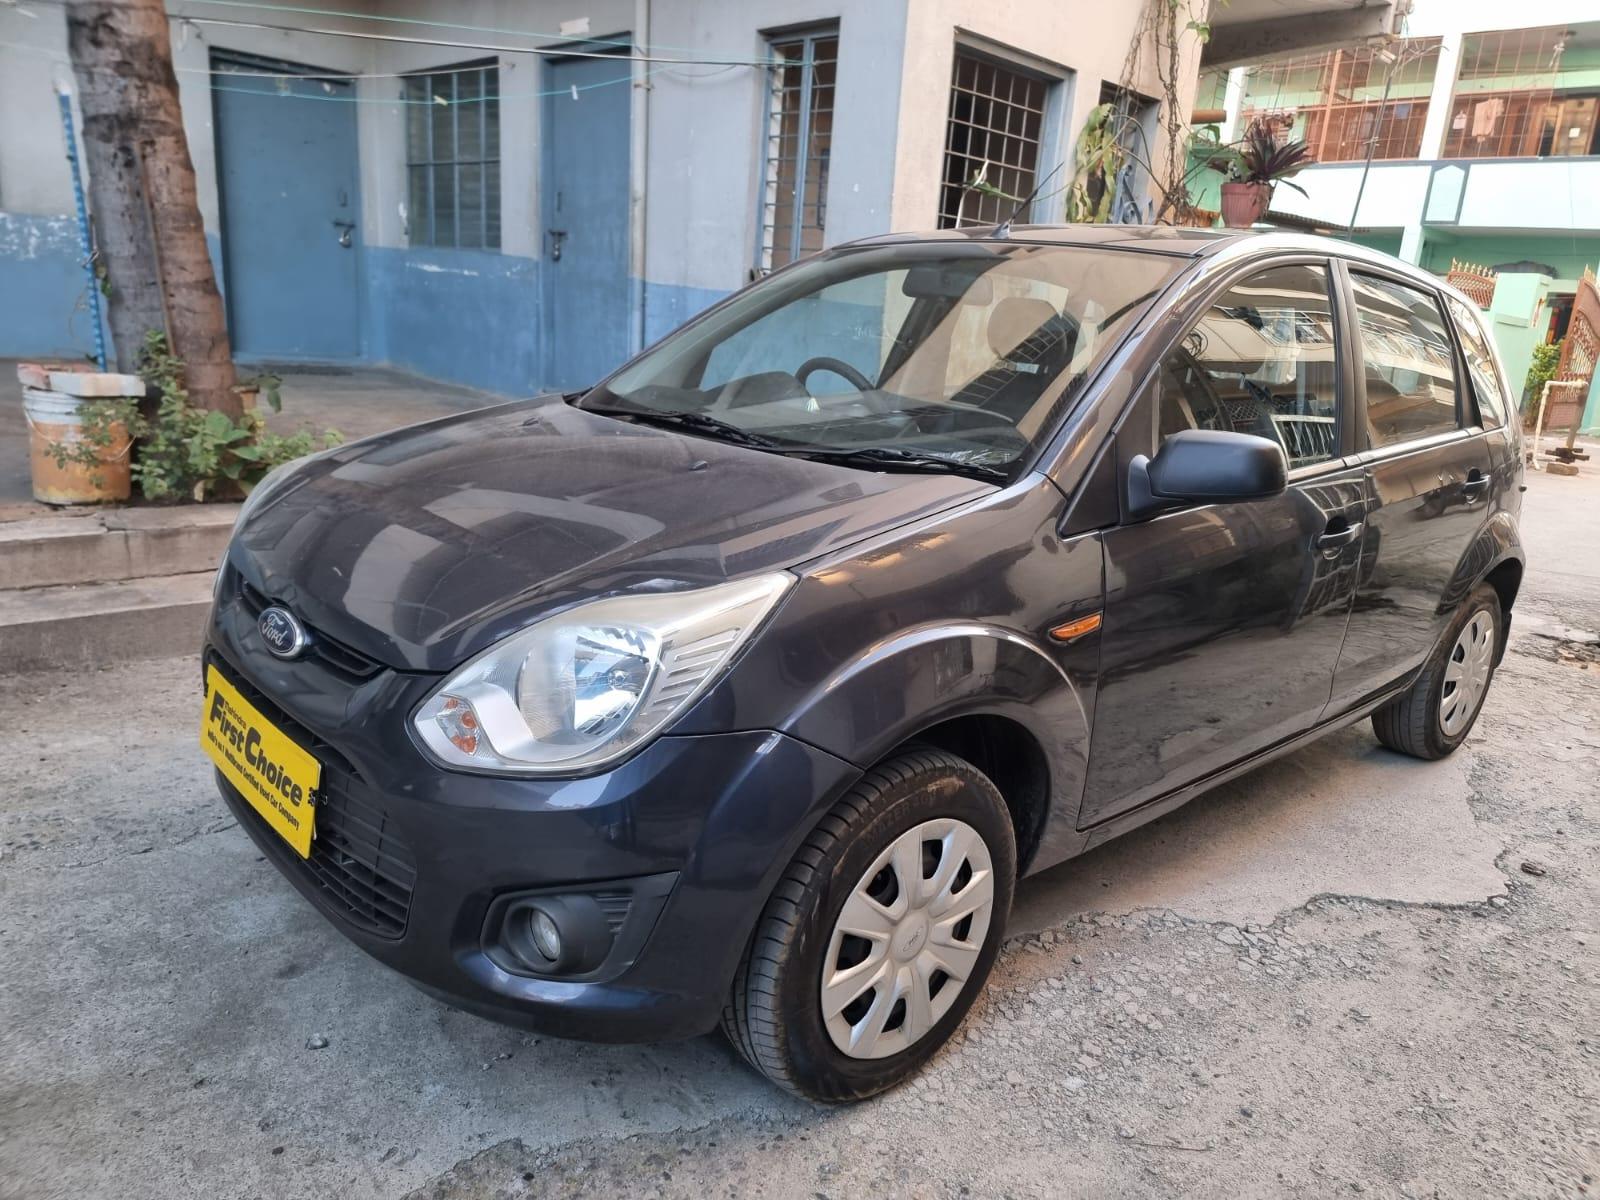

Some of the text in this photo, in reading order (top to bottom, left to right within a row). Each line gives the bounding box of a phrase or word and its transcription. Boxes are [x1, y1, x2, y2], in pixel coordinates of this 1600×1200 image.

[262, 613, 288, 647] Ford
[209, 689, 302, 807] First Choice
[278, 802, 300, 831] Company
